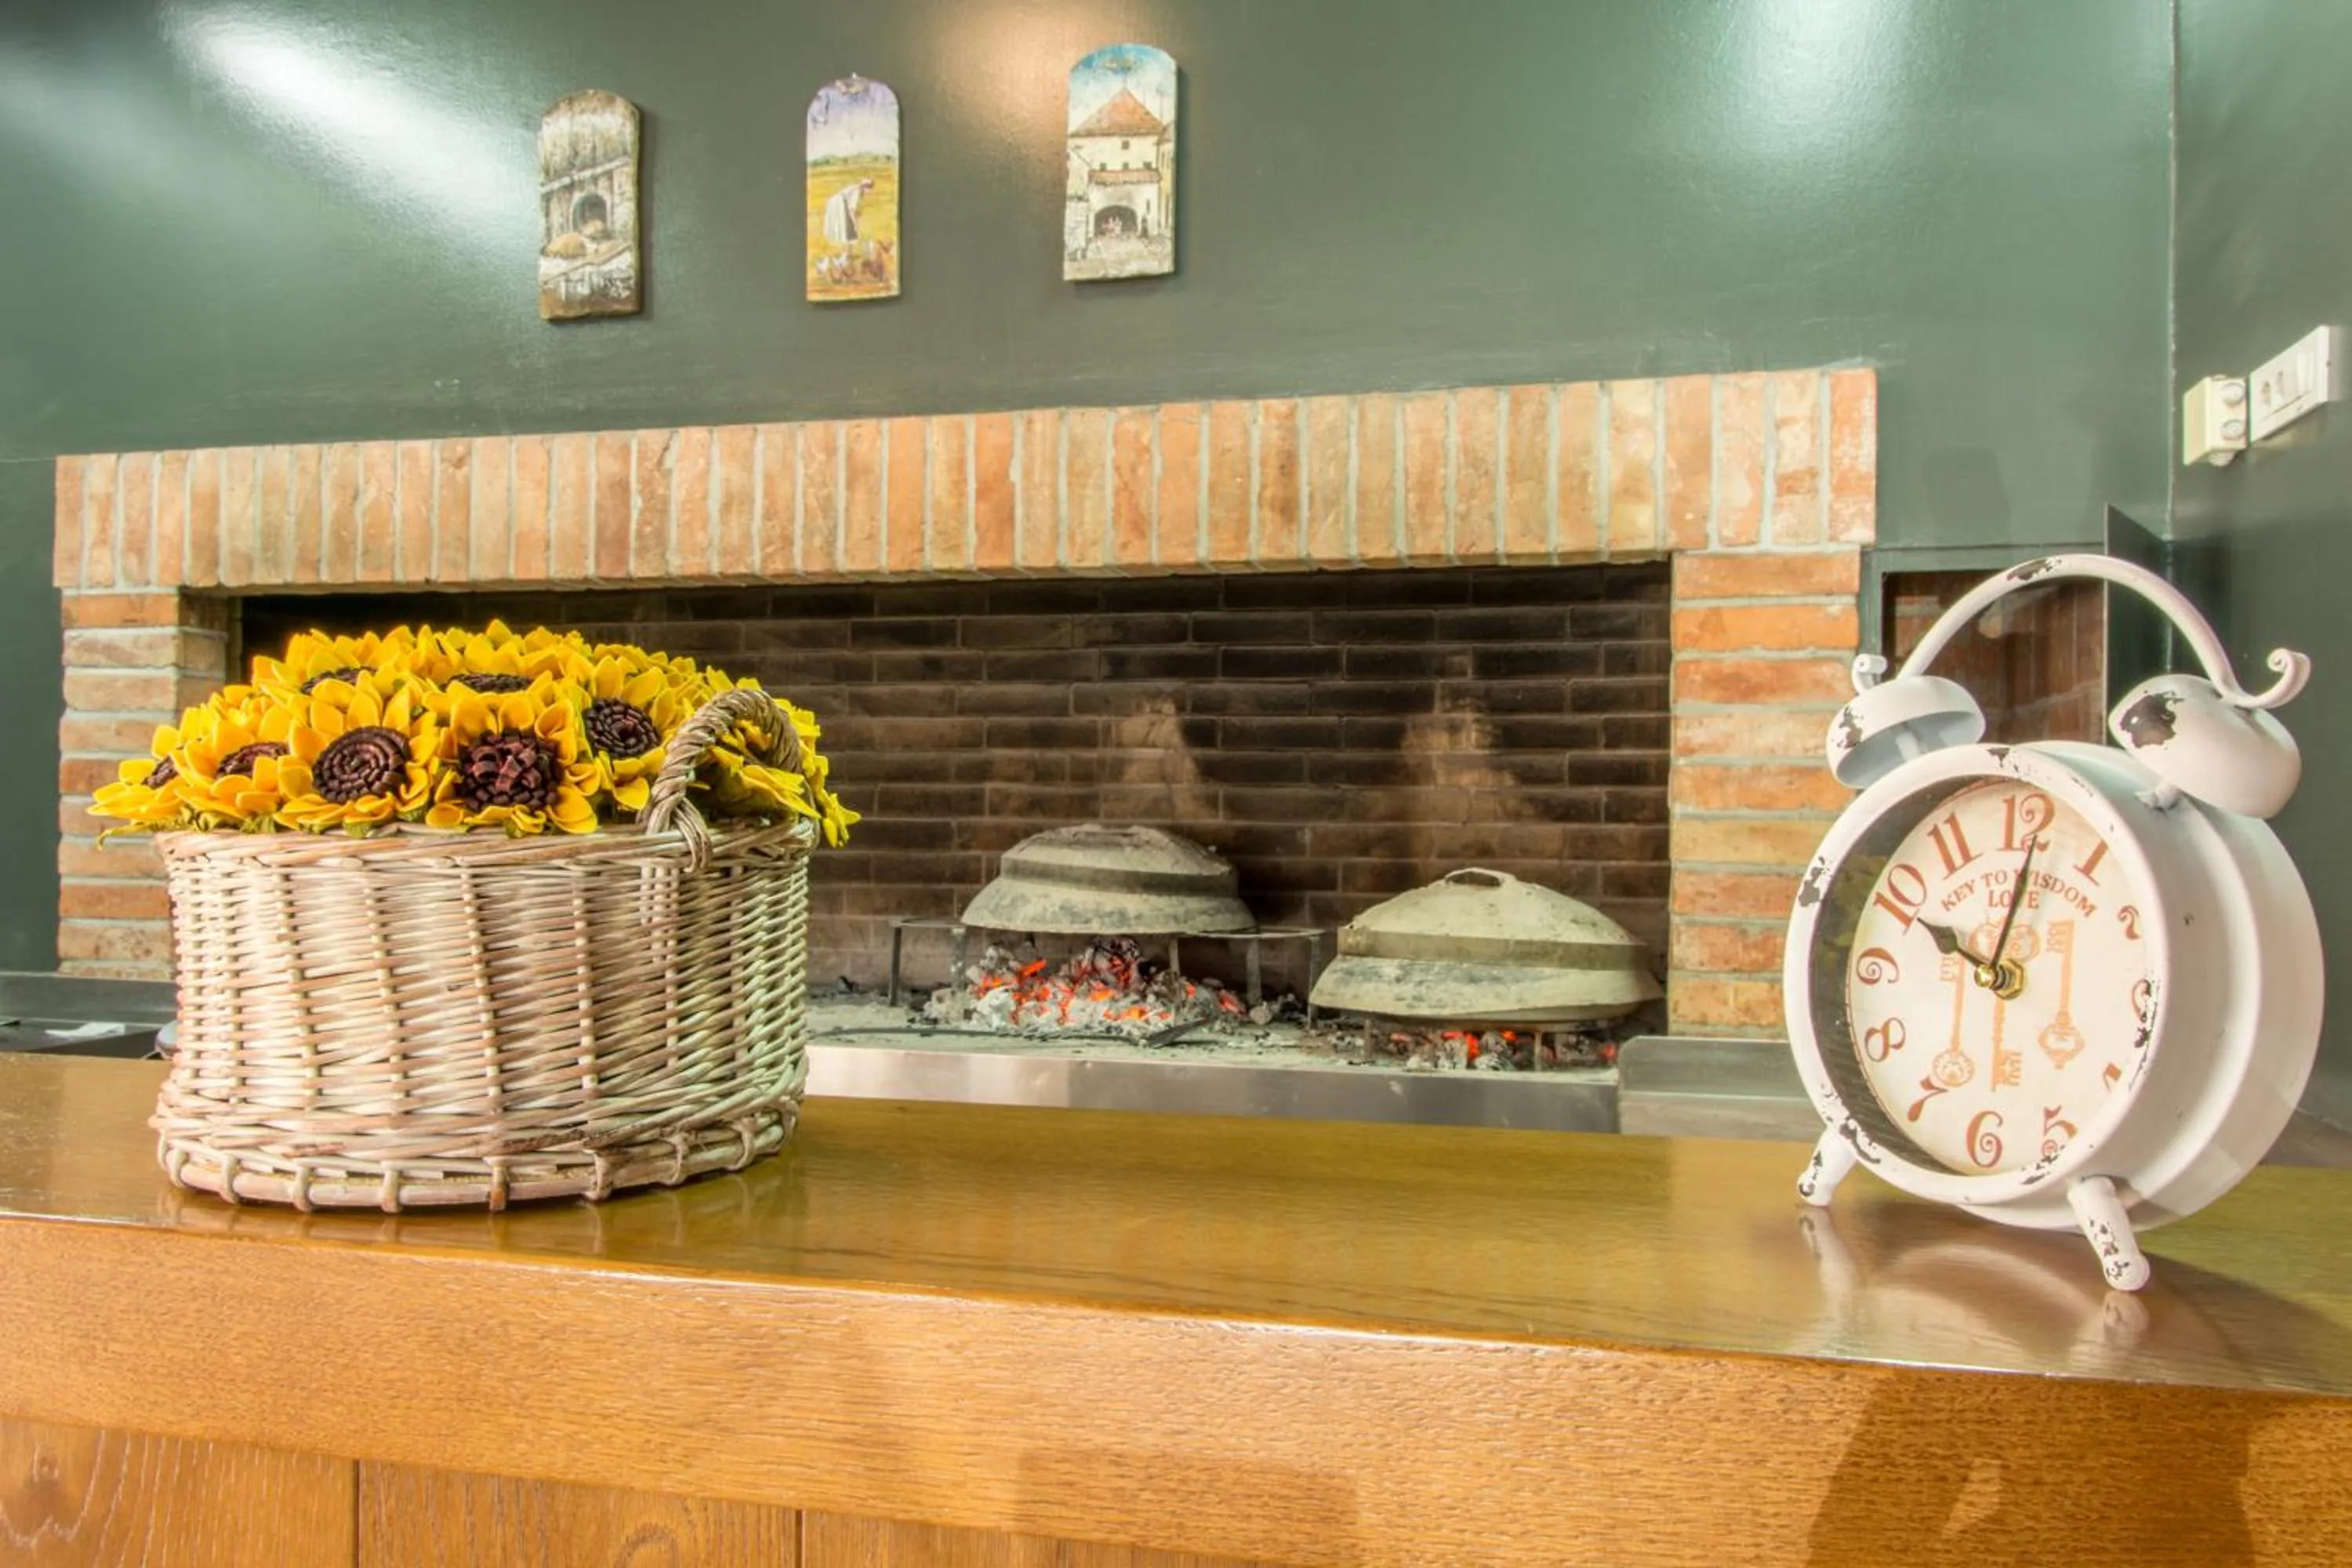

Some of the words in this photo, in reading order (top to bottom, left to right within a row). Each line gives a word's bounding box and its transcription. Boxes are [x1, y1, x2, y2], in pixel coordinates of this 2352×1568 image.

[1926, 811, 1984, 880] 11
[1996, 793, 2056, 852] 12
[1873, 863, 1928, 935] 10
[1940, 879, 1976, 913] KEY
[1980, 869, 2008, 888] TO
[2014, 869, 2098, 919] ISDOM
[1988, 889, 2040, 910] LOE
[1856, 946, 1900, 985] 9
[1864, 1017, 1907, 1063] 8
[1907, 1075, 1950, 1123] 7
[1965, 1110, 2004, 1168] 6
[2042, 1105, 2078, 1157] 5
